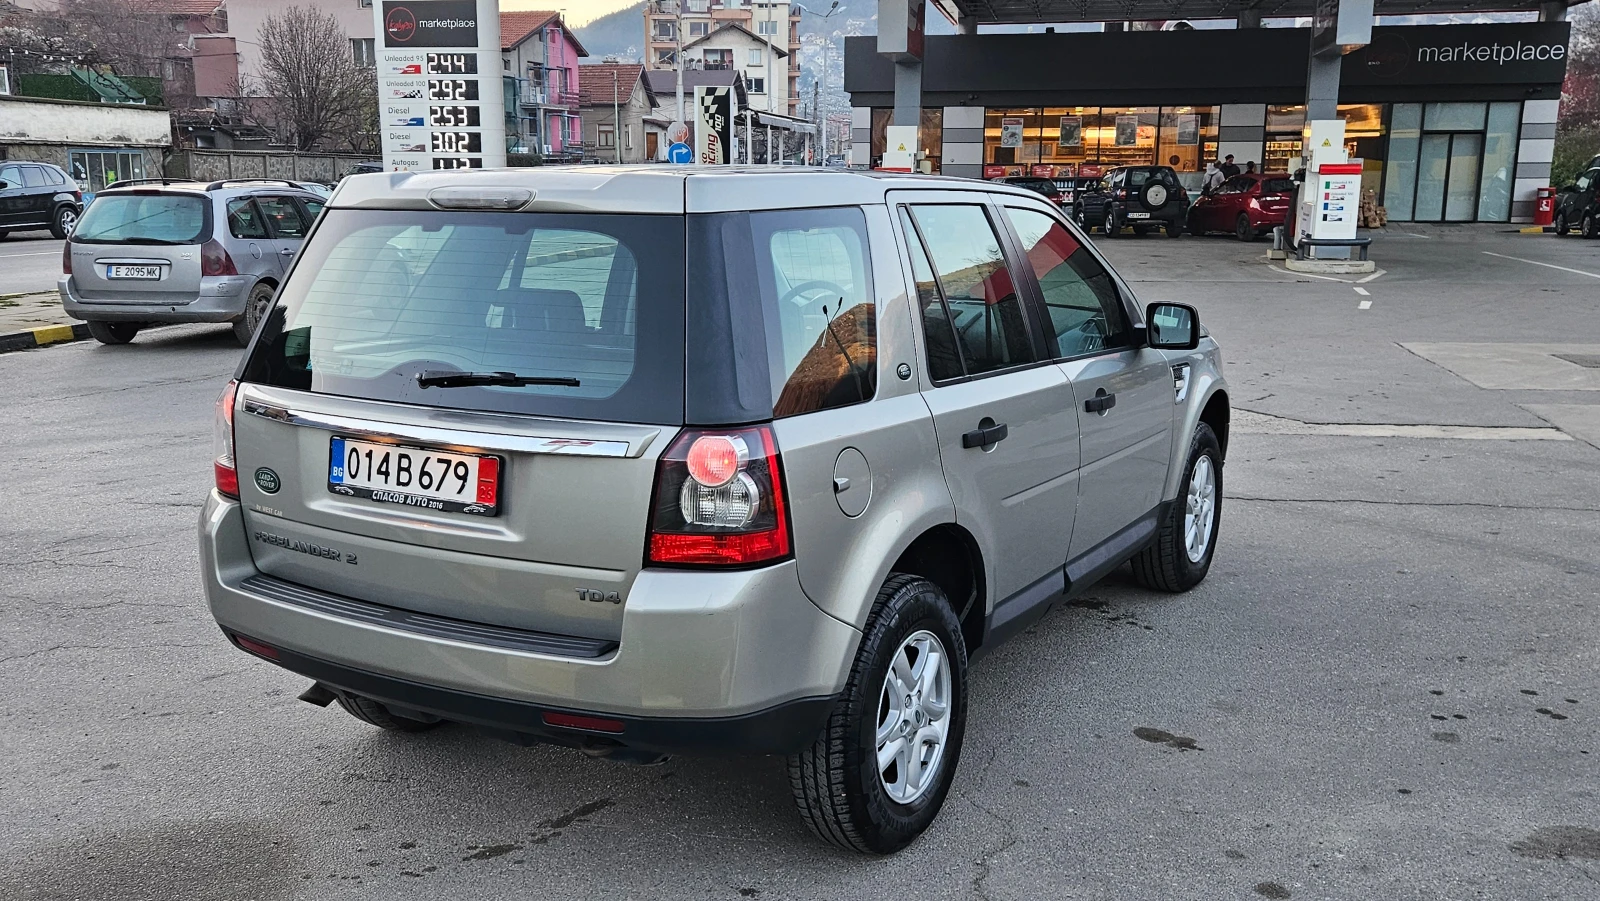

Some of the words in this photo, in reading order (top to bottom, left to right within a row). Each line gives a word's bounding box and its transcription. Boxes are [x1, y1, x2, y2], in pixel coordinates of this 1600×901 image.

[419, 18, 475, 29] marketplace
[1417, 41, 1565, 65] marketplace
[427, 53, 465, 74] 2.44
[386, 79, 414, 87] Unleaded
[415, 79, 426, 87] 100
[429, 80, 467, 100] 2.92
[430, 106, 468, 126] 2.53
[432, 132, 469, 152] 3.02
[391, 159, 419, 167] Autogas
[115, 267, 121, 276] E
[125, 267, 145, 277] 2095
[146, 267, 158, 277] MK
[259, 472, 271, 482] LAND
[333, 466, 343, 478] BG
[348, 446, 469, 495] 014B679
[260, 480, 275, 489] ROVER
[480, 486, 493, 500] 26
[372, 490, 405, 504] СПАСОВ
[406, 494, 428, 508] АУТО
[428, 501, 443, 510] 2016
[255, 531, 341, 562] FREELANDER
[345, 552, 358, 565] 2
[575, 586, 621, 605] TD4
